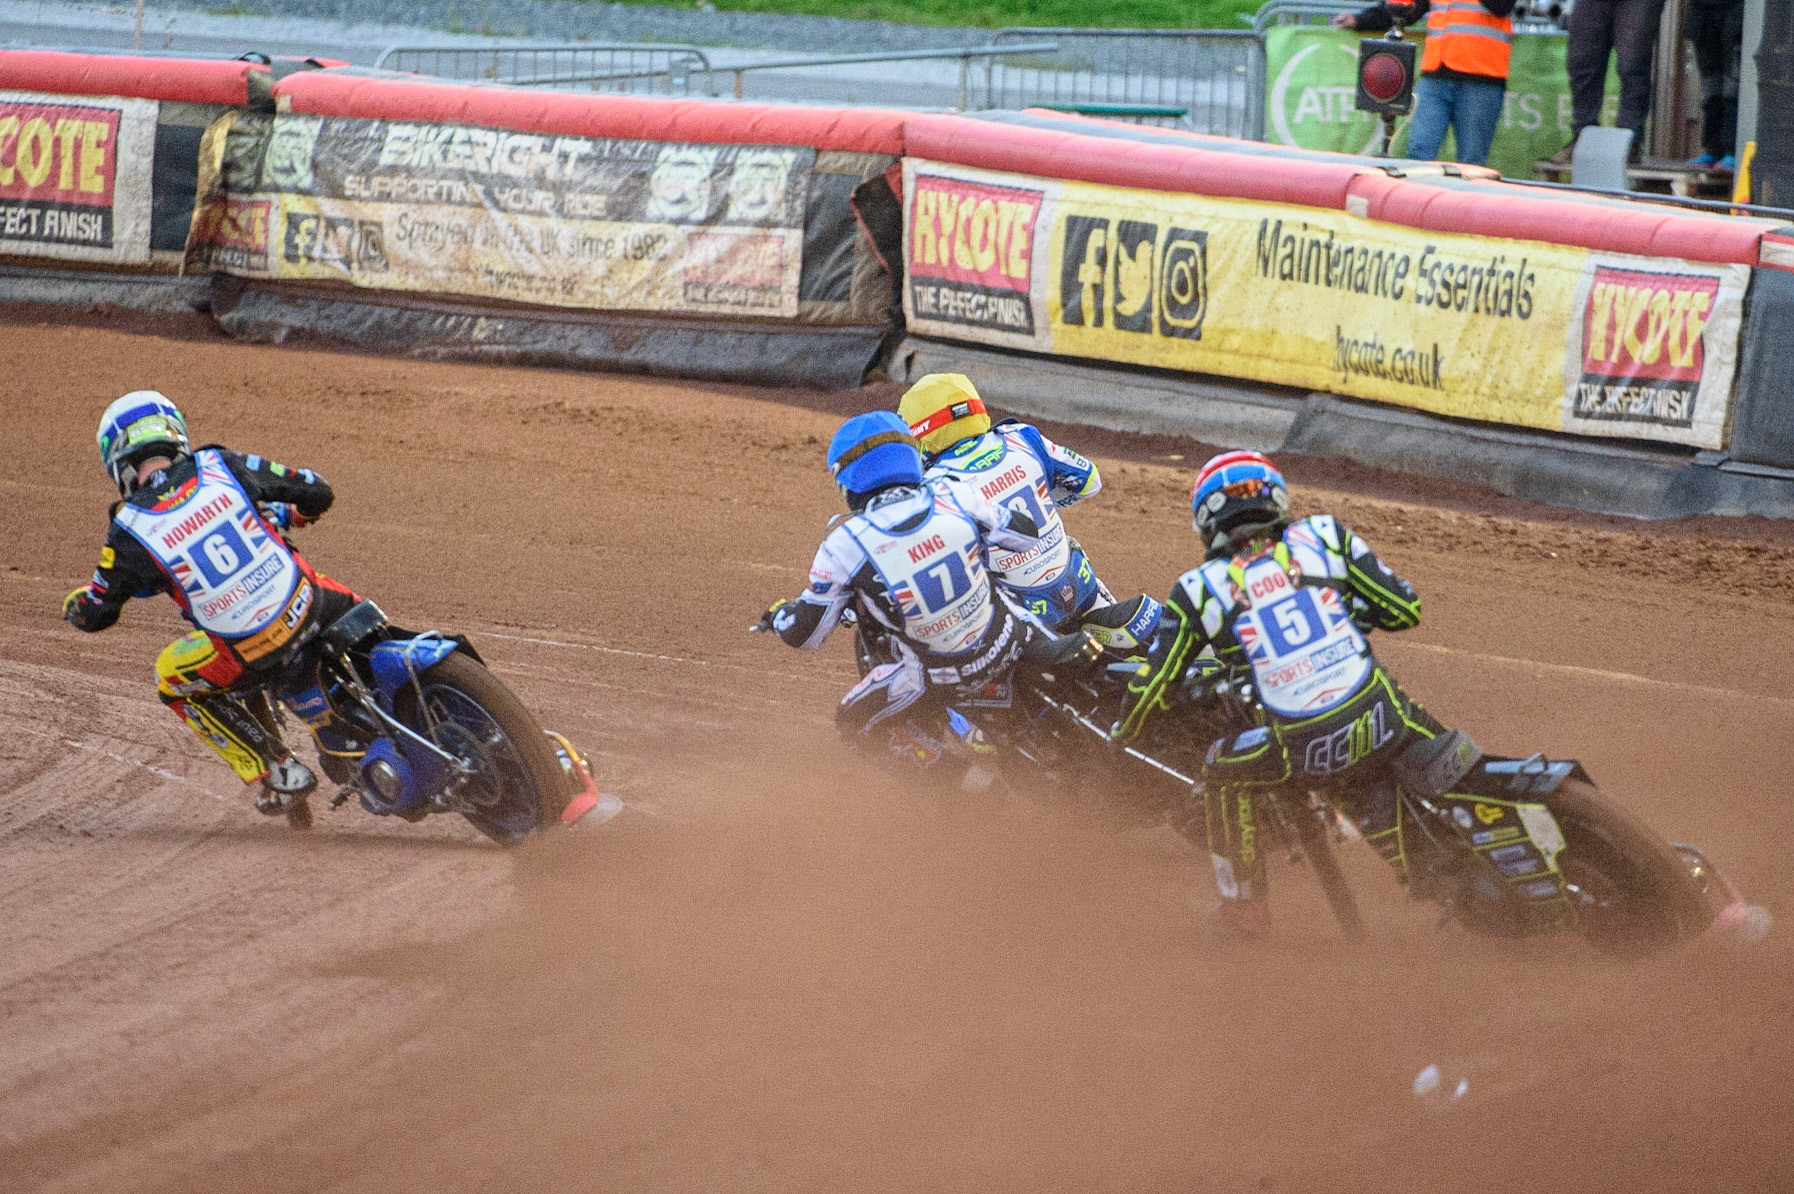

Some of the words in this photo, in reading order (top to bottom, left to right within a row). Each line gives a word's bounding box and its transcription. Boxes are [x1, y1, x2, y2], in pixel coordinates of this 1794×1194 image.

[43, 209, 103, 241] FINISH
[914, 189, 1034, 279] HYCOTE
[1256, 217, 1410, 301] Maintenance
[1414, 243, 1536, 320] Essentials
[914, 285, 937, 313] THE
[1588, 282, 1710, 367] HYCOTE
[1333, 325, 1445, 390] hycote.co.uk
[980, 465, 1027, 500] HARRIS
[161, 493, 233, 549] HOWARTH
[203, 533, 240, 575] 6
[907, 534, 946, 564] KING
[998, 546, 1039, 572] SPORTS
[202, 584, 247, 618] SPORTS
[243, 554, 284, 594] INSURE
[928, 562, 956, 602] 7
[1251, 572, 1286, 599] COO
[916, 610, 961, 638] SPORTS
[1272, 598, 1312, 646] 5
[1265, 657, 1314, 689] SPORTS
